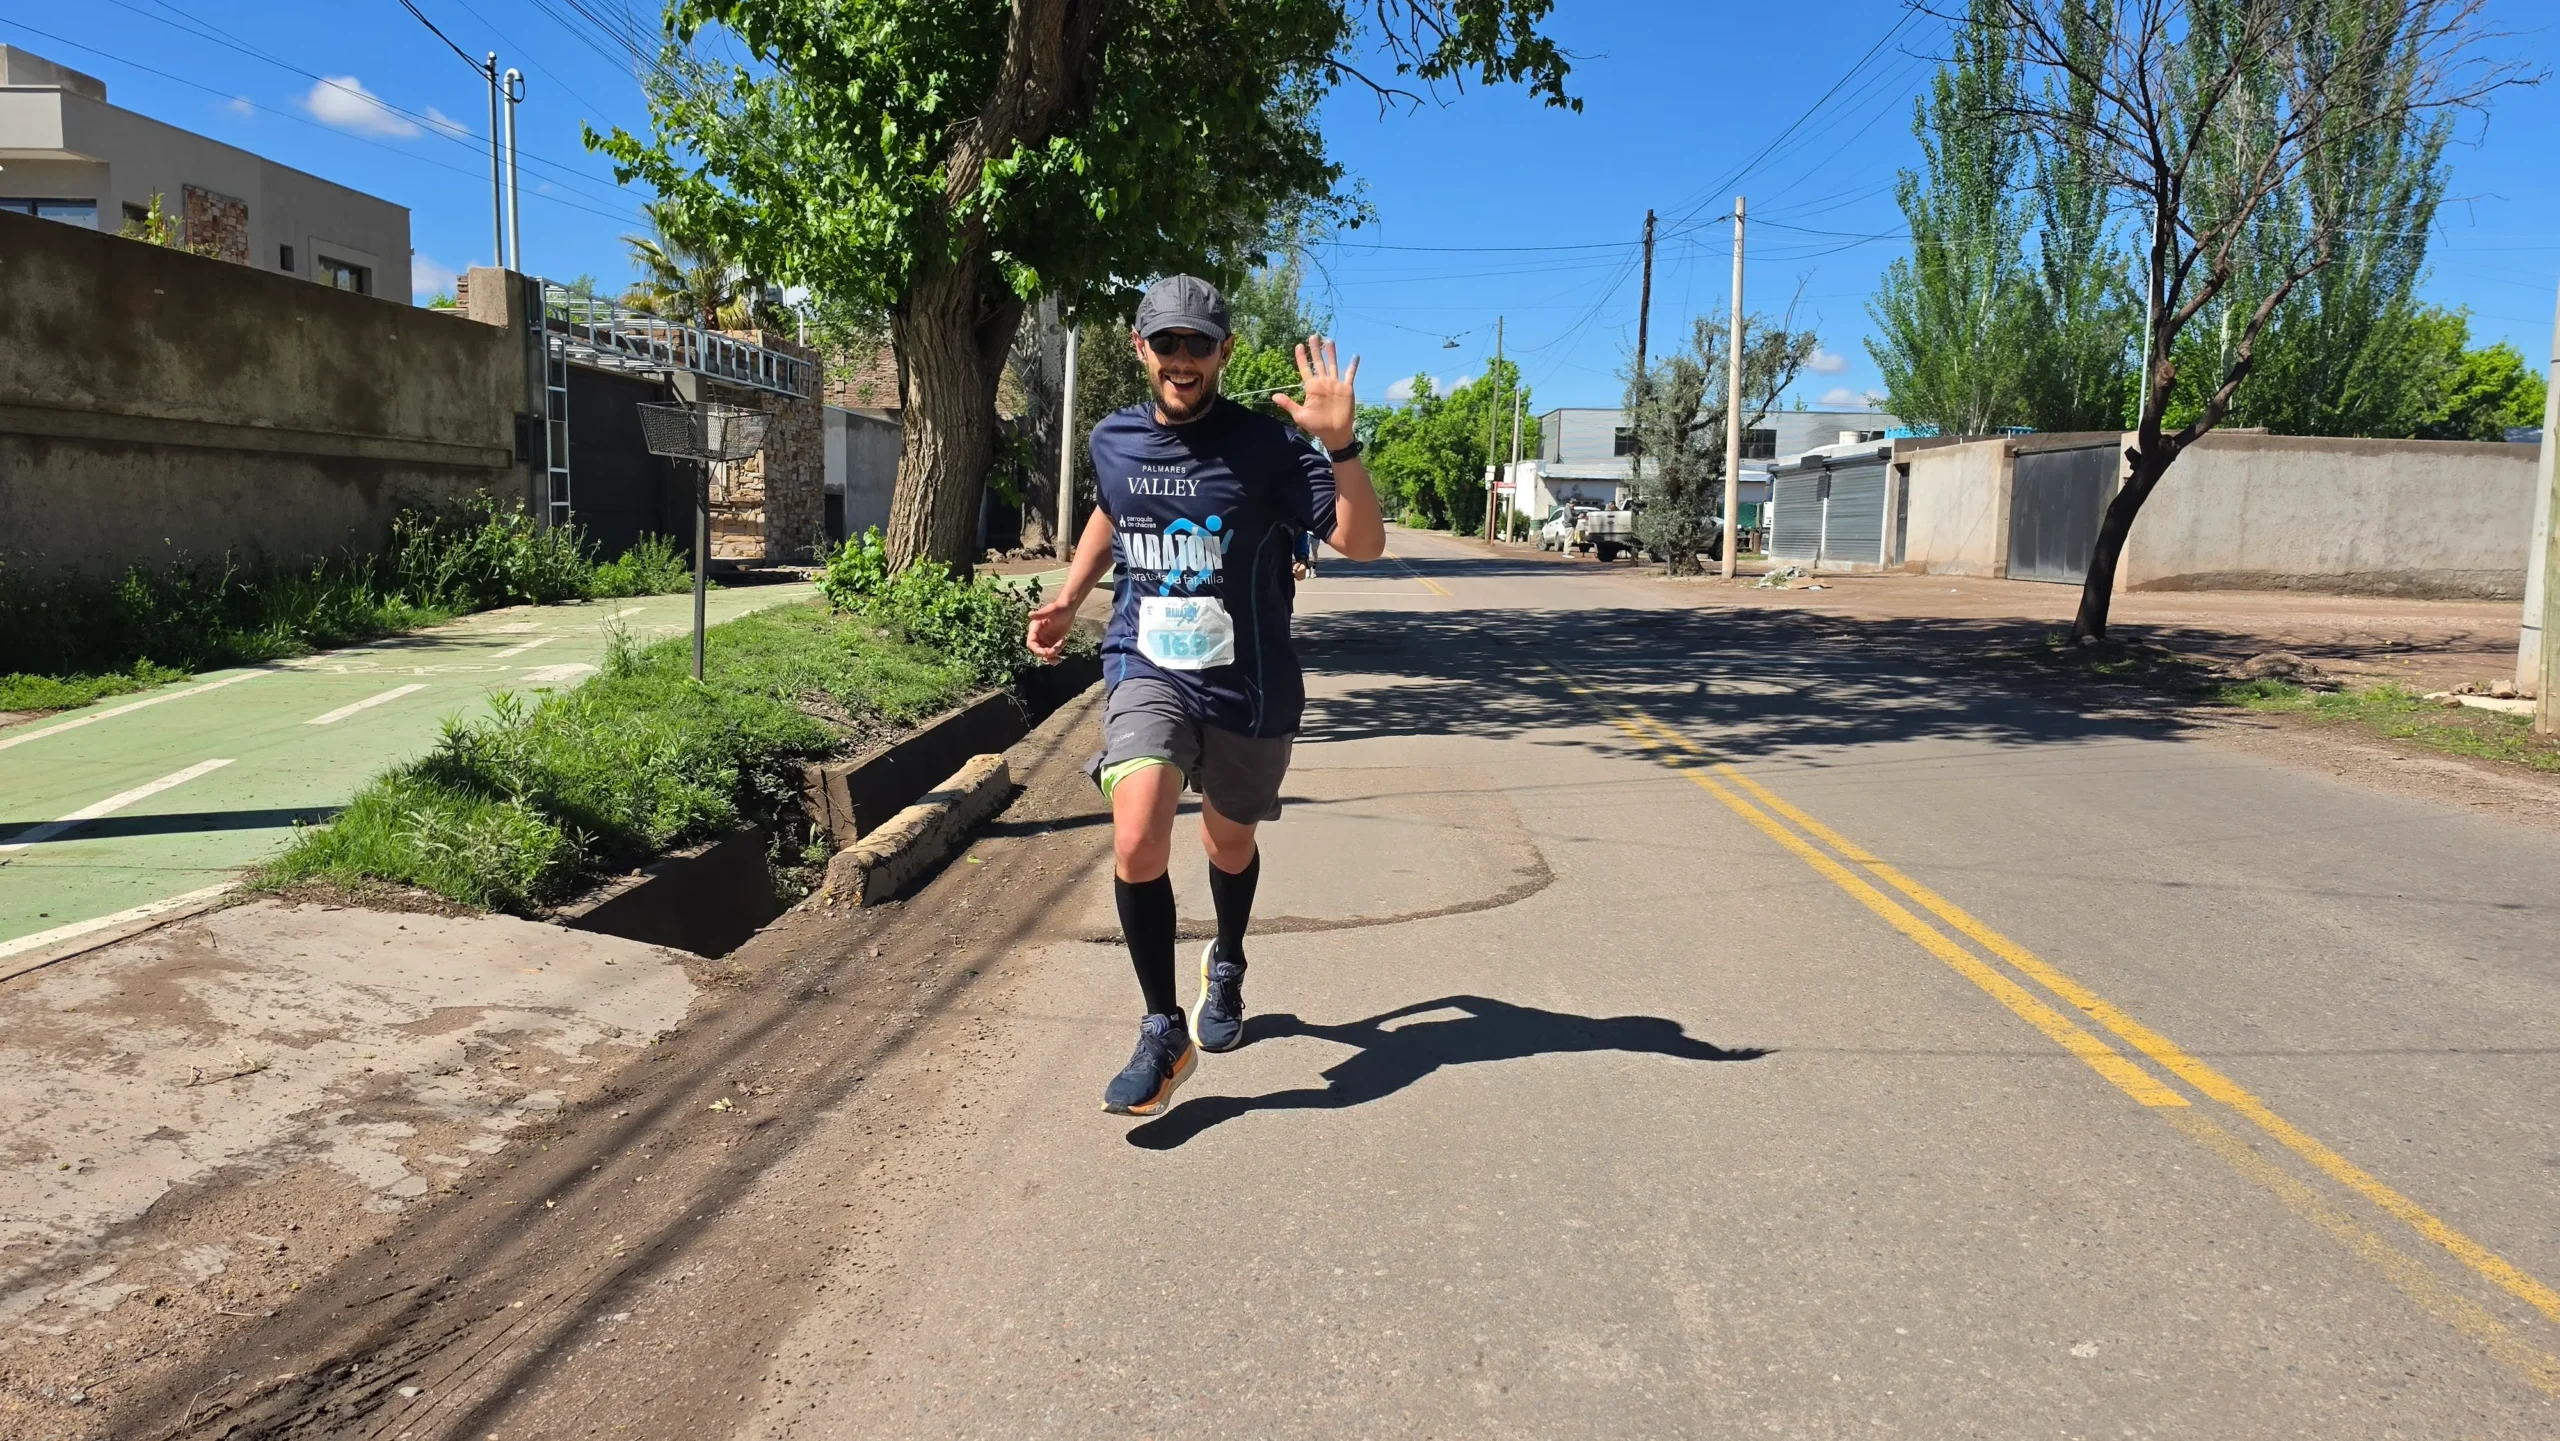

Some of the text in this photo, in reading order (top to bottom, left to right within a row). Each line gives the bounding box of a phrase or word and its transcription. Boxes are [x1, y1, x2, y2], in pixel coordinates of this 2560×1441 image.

[1142, 465, 1186, 474] PALMARES
[1127, 477, 1200, 497] VALLEY
[1160, 633, 1209, 656] 169
